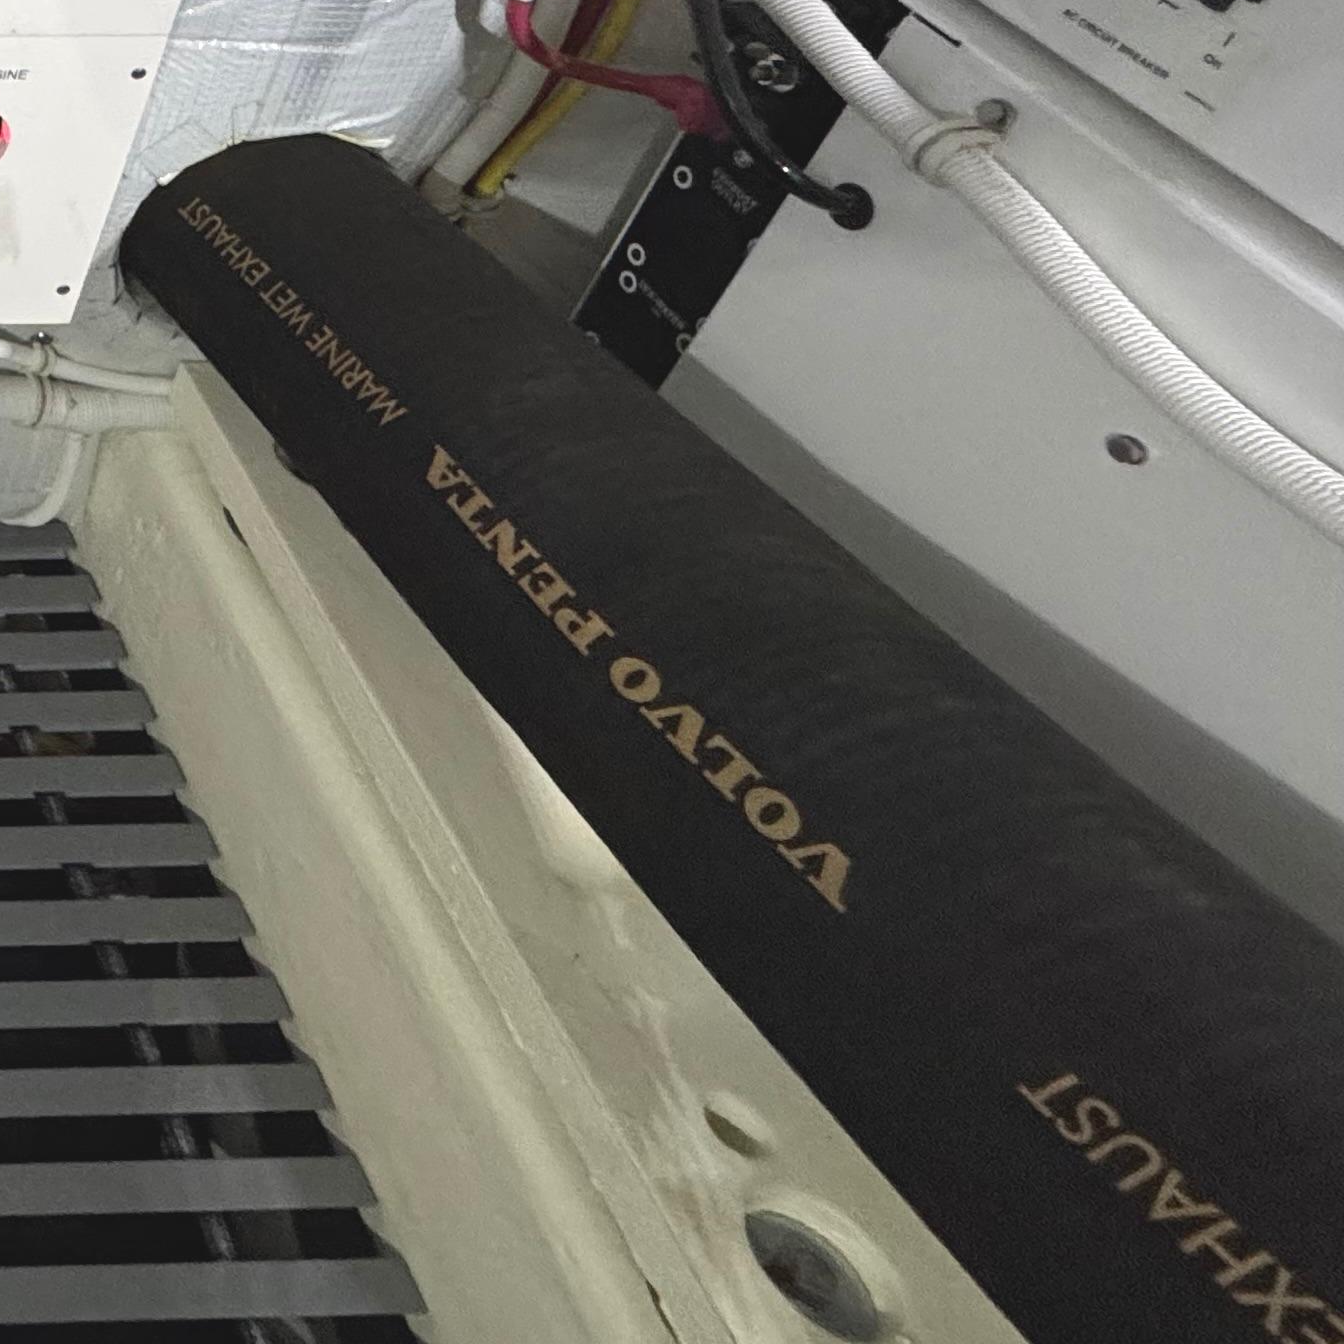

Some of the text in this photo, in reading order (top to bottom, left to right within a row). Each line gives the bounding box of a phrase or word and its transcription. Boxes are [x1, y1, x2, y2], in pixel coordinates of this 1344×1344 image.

[1117, 43, 1169, 79] BREAKER
[177, 197, 408, 427] MARINE WET EXHAUST
[425, 444, 851, 914] VOLVO PENTA
